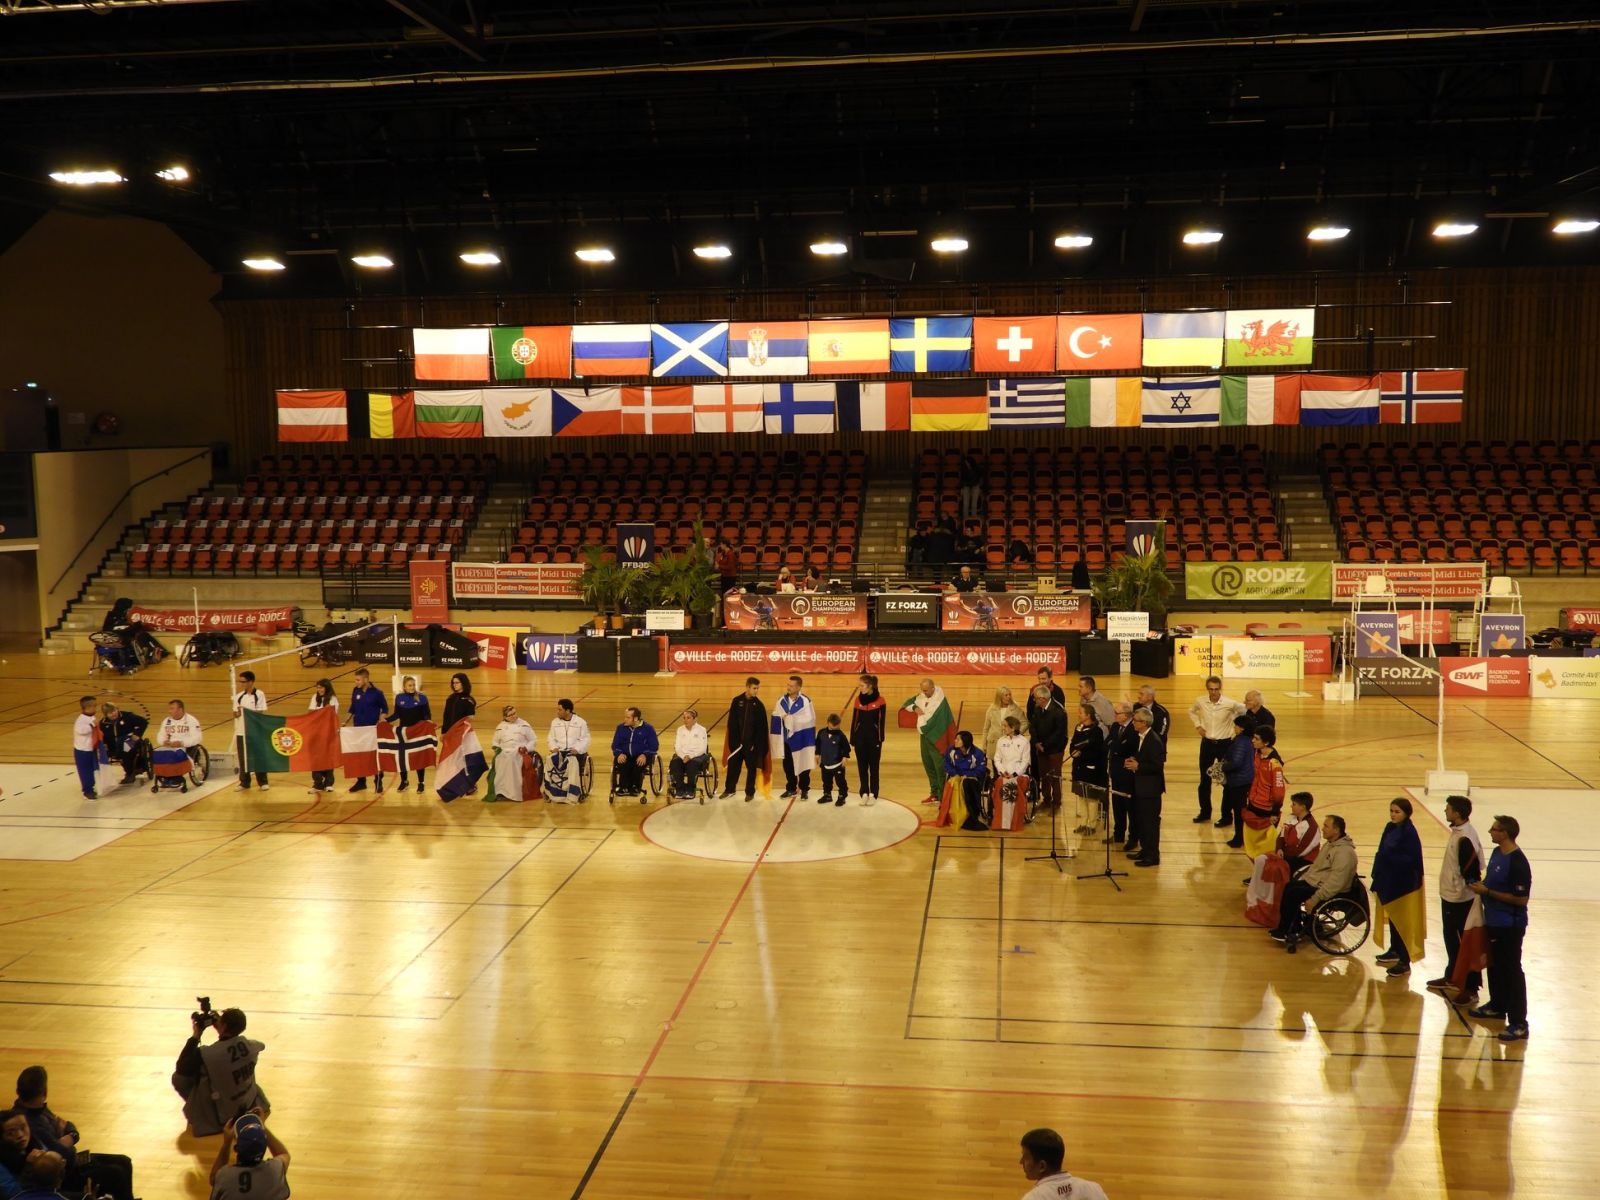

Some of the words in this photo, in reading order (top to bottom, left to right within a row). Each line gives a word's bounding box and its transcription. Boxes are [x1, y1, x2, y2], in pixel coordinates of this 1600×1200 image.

[1245, 568, 1306, 583] RODEZ
[164, 616, 175, 625] de
[221, 614, 243, 624] VILLE
[246, 614, 256, 624] de
[686, 650, 711, 662] VILLE
[715, 650, 726, 662] de
[731, 650, 762, 662] RODEZ
[782, 650, 806, 662] VILLE
[810, 650, 822, 662] de
[826, 650, 858, 662] RODEZ
[882, 652, 908, 663] VILLE
[912, 652, 924, 663] de
[928, 652, 960, 663] RODEZ
[979, 652, 1006, 664] VILLE
[1010, 652, 1022, 664] de
[1026, 652, 1059, 664] RODEZ
[1359, 668, 1376, 678] FZ
[1382, 668, 1433, 678] FORZA
[227, 1041, 249, 1063] 29
[239, 1171, 252, 1193] 9
